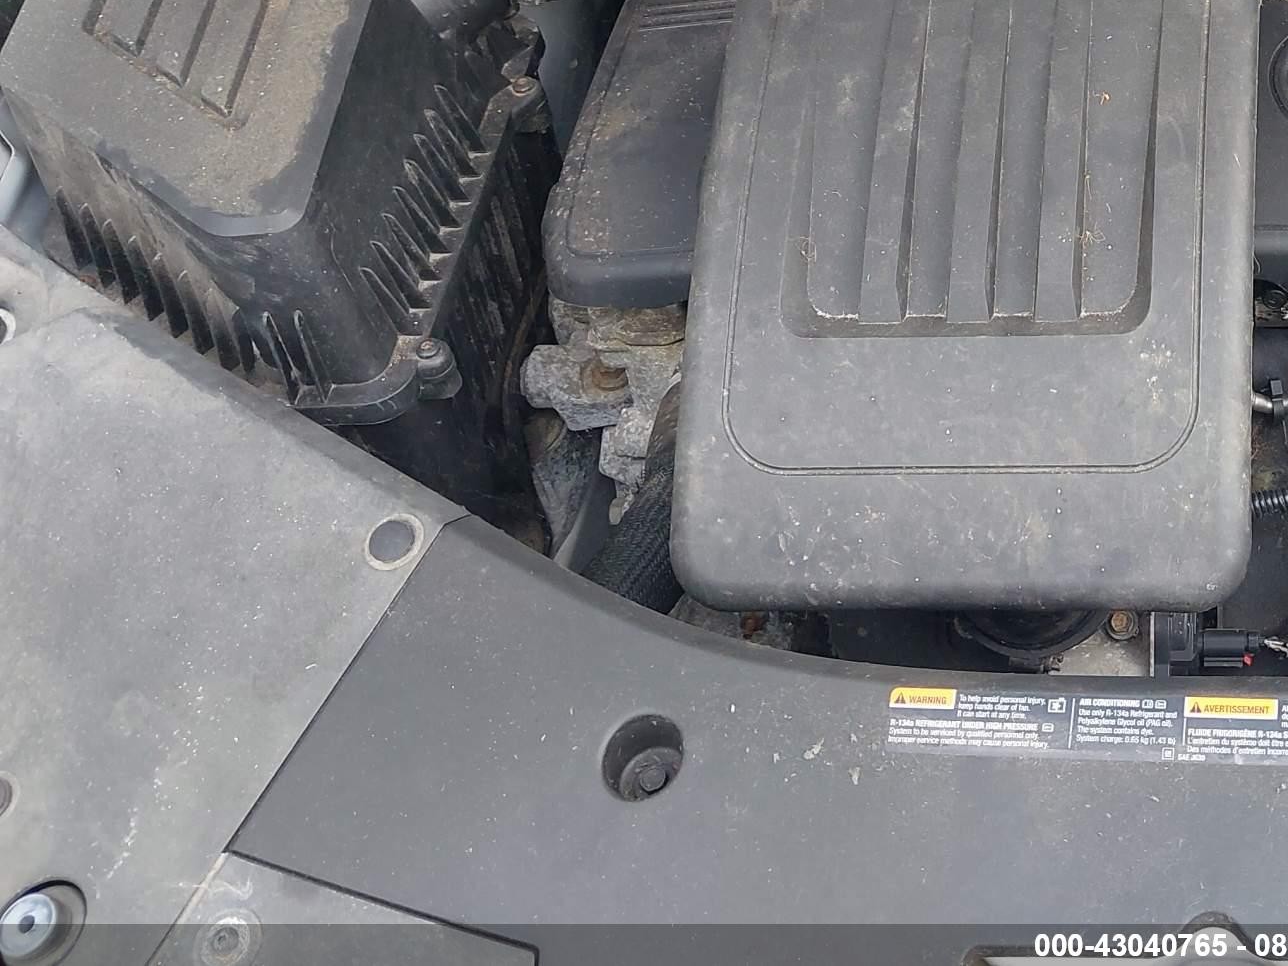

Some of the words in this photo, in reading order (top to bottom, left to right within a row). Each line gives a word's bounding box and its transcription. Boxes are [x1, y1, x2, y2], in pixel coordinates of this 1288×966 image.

[909, 696, 946, 704] WARNING
[968, 695, 981, 704] help
[1080, 698, 1092, 706] AIR
[1093, 699, 1140, 707] CONDITIONING
[959, 702, 973, 710] keep
[1204, 704, 1270, 714] AVERTISSEMENT
[999, 712, 1010, 720] any
[1092, 709, 1104, 718] only
[1106, 709, 1129, 717] R-134a
[1130, 710, 1164, 718] Refrigerant
[915, 719, 961, 728] REFRIGERANT
[962, 720, 984, 729] UNDER
[1004, 722, 1038, 731] PRESSURE
[1078, 717, 1116, 726] Polyalkylene
[1117, 718, 1136, 727] Glycol
[1146, 719, 1160, 728] (PAG
[1162, 720, 1173, 728] oil).
[889, 727, 912, 735] System
[957, 730, 966, 738] by
[966, 731, 993, 739] qualified
[1077, 725, 1089, 733] The
[1141, 728, 1154, 736] dye.
[1188, 728, 1211, 736] FLUIDE
[1258, 730, 1282, 738] R-134a
[888, 735, 915, 743] Improper
[1030, 741, 1050, 749] injury.
[1076, 734, 1099, 743] System
[1100, 735, 1124, 744] charge:
[1125, 736, 1139, 744] 0.65
[1140, 736, 1149, 744] kg
[1168, 737, 1176, 745] lb)
